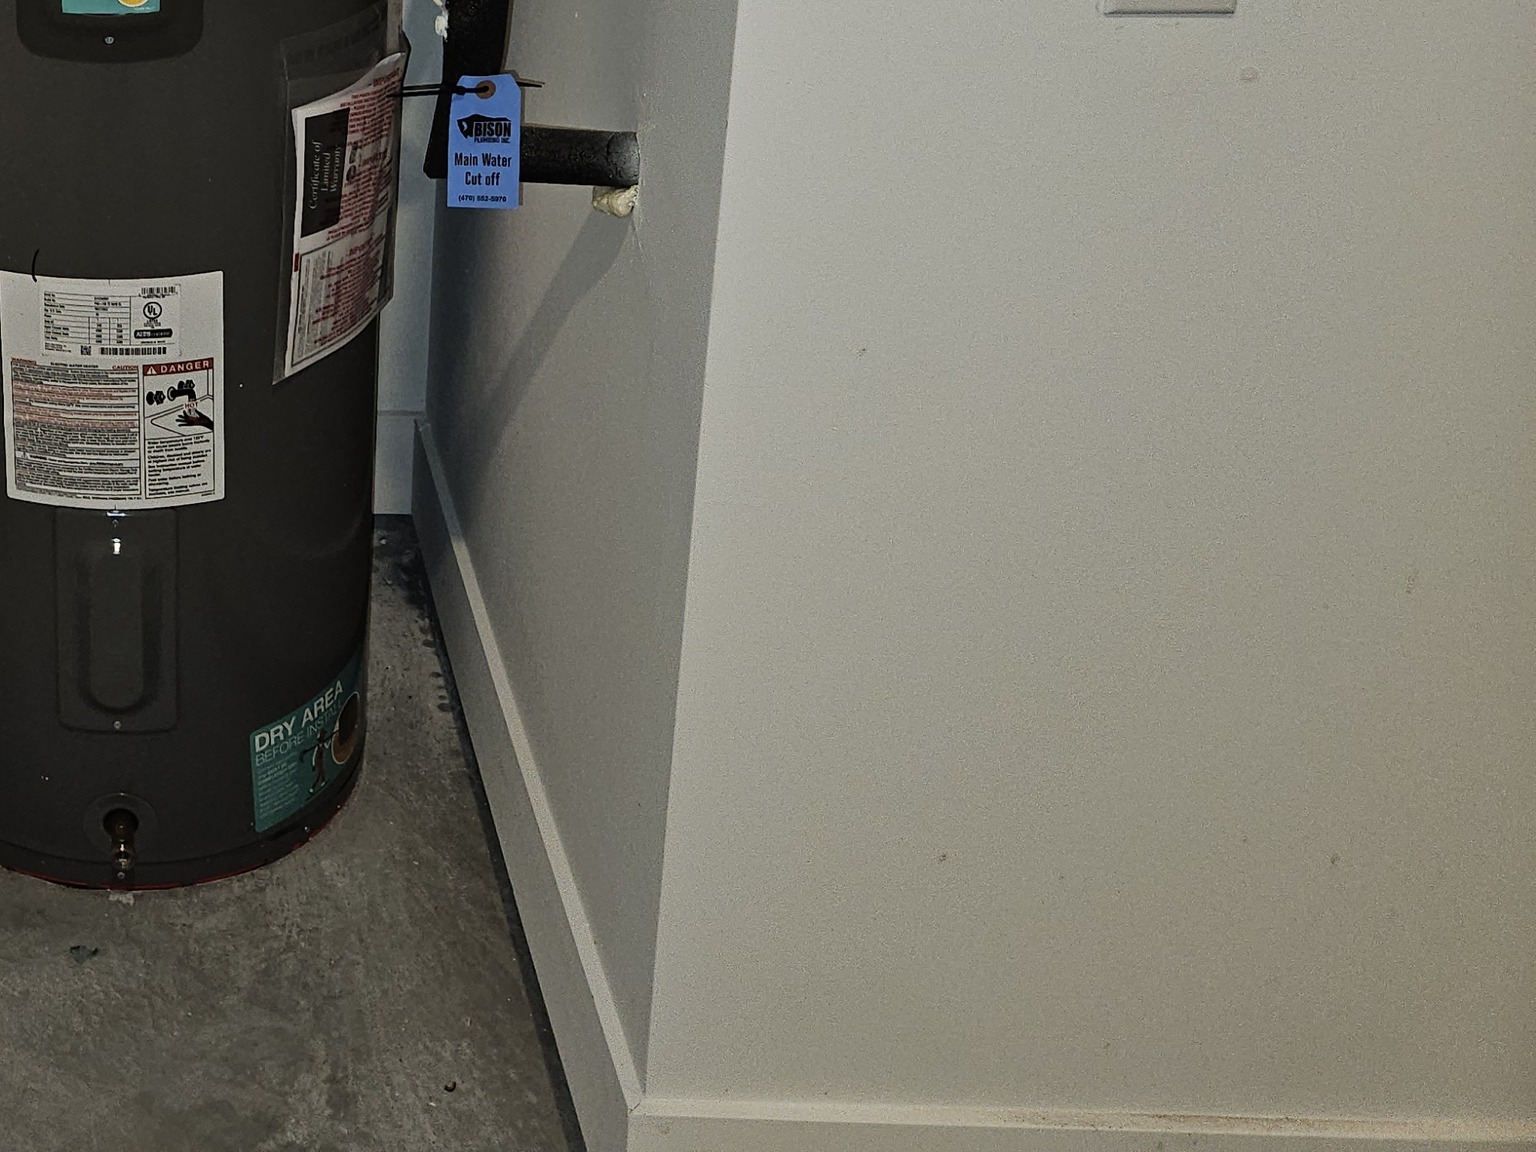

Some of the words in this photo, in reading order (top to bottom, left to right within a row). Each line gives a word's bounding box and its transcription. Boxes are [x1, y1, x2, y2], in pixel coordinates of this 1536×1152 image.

[474, 122, 512, 138] BISON
[312, 139, 323, 152] of
[321, 153, 330, 191] Limited
[330, 145, 342, 192] Warranty
[455, 153, 478, 166] Main
[482, 153, 512, 167] Water
[309, 155, 320, 209] Certificate
[465, 172, 482, 185] Cut
[485, 172, 500, 185] off
[161, 360, 209, 373] DANGER
[255, 716, 296, 752] DRY
[301, 680, 343, 728] AREA
[255, 730, 304, 767] BEFORE
